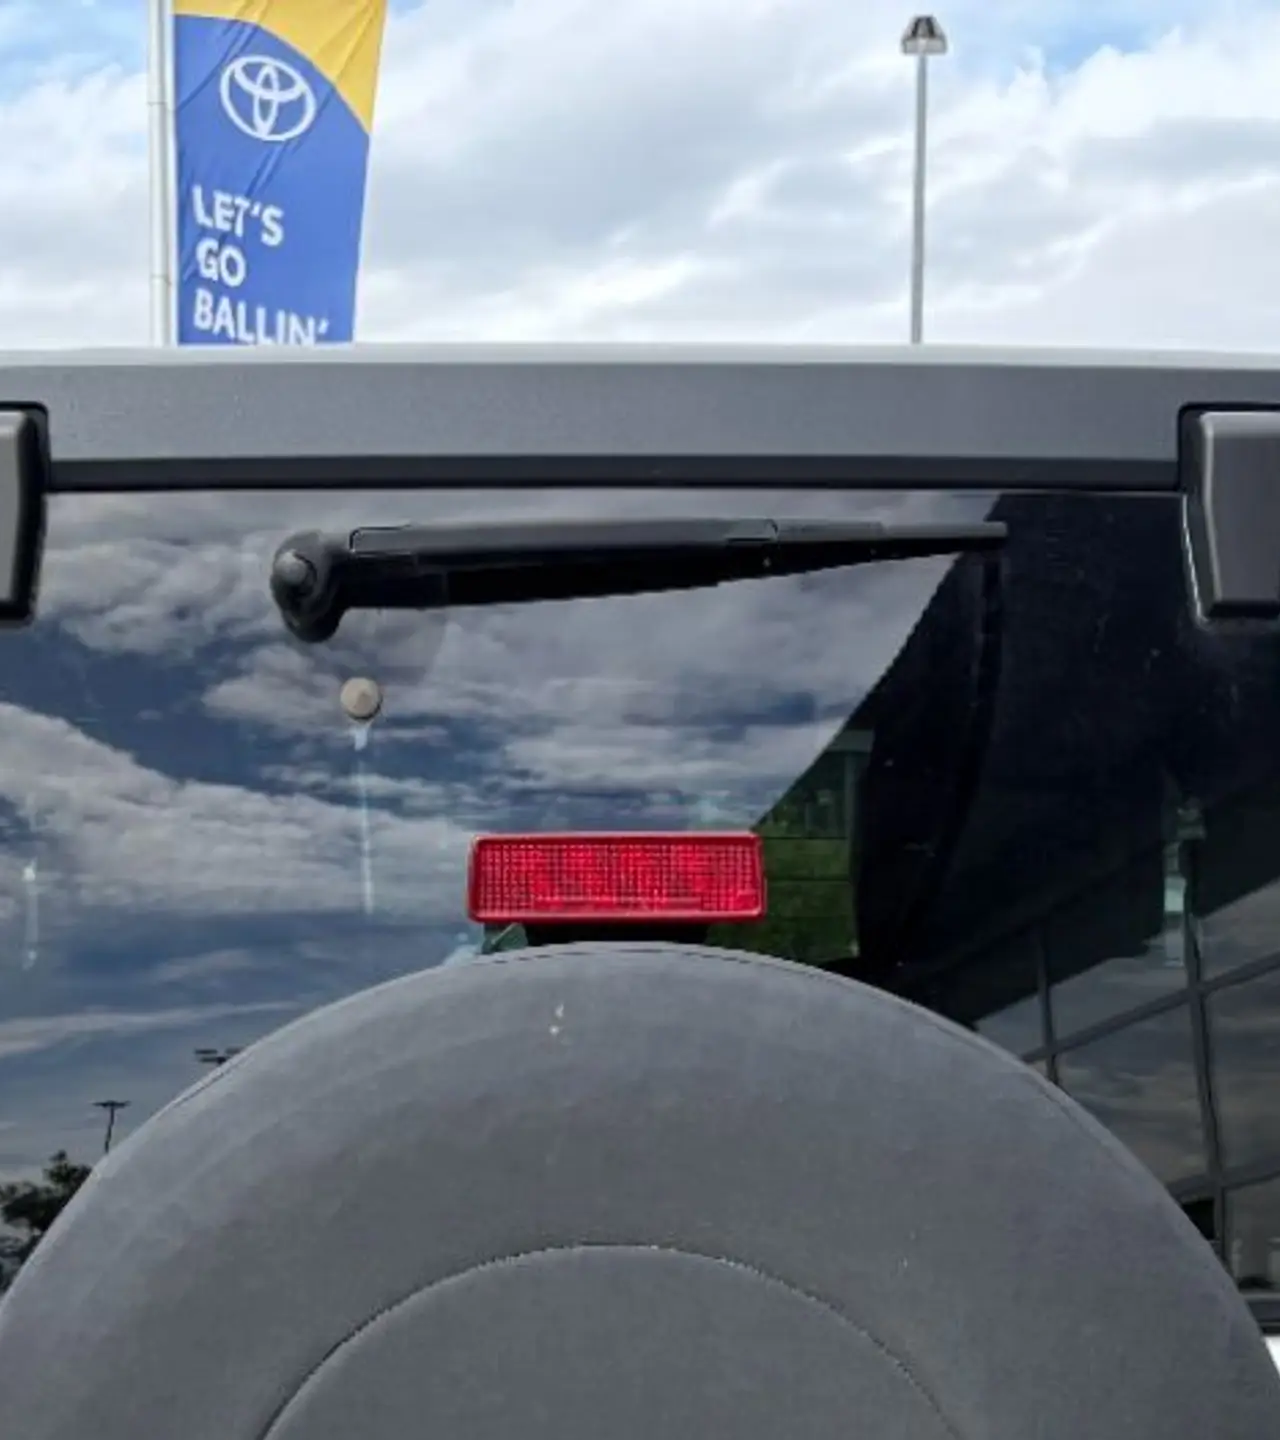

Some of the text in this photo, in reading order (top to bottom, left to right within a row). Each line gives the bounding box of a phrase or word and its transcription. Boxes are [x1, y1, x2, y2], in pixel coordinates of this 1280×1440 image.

[192, 184, 285, 246] LET'S
[195, 236, 246, 287] GO
[193, 287, 330, 345] BALLIN'
